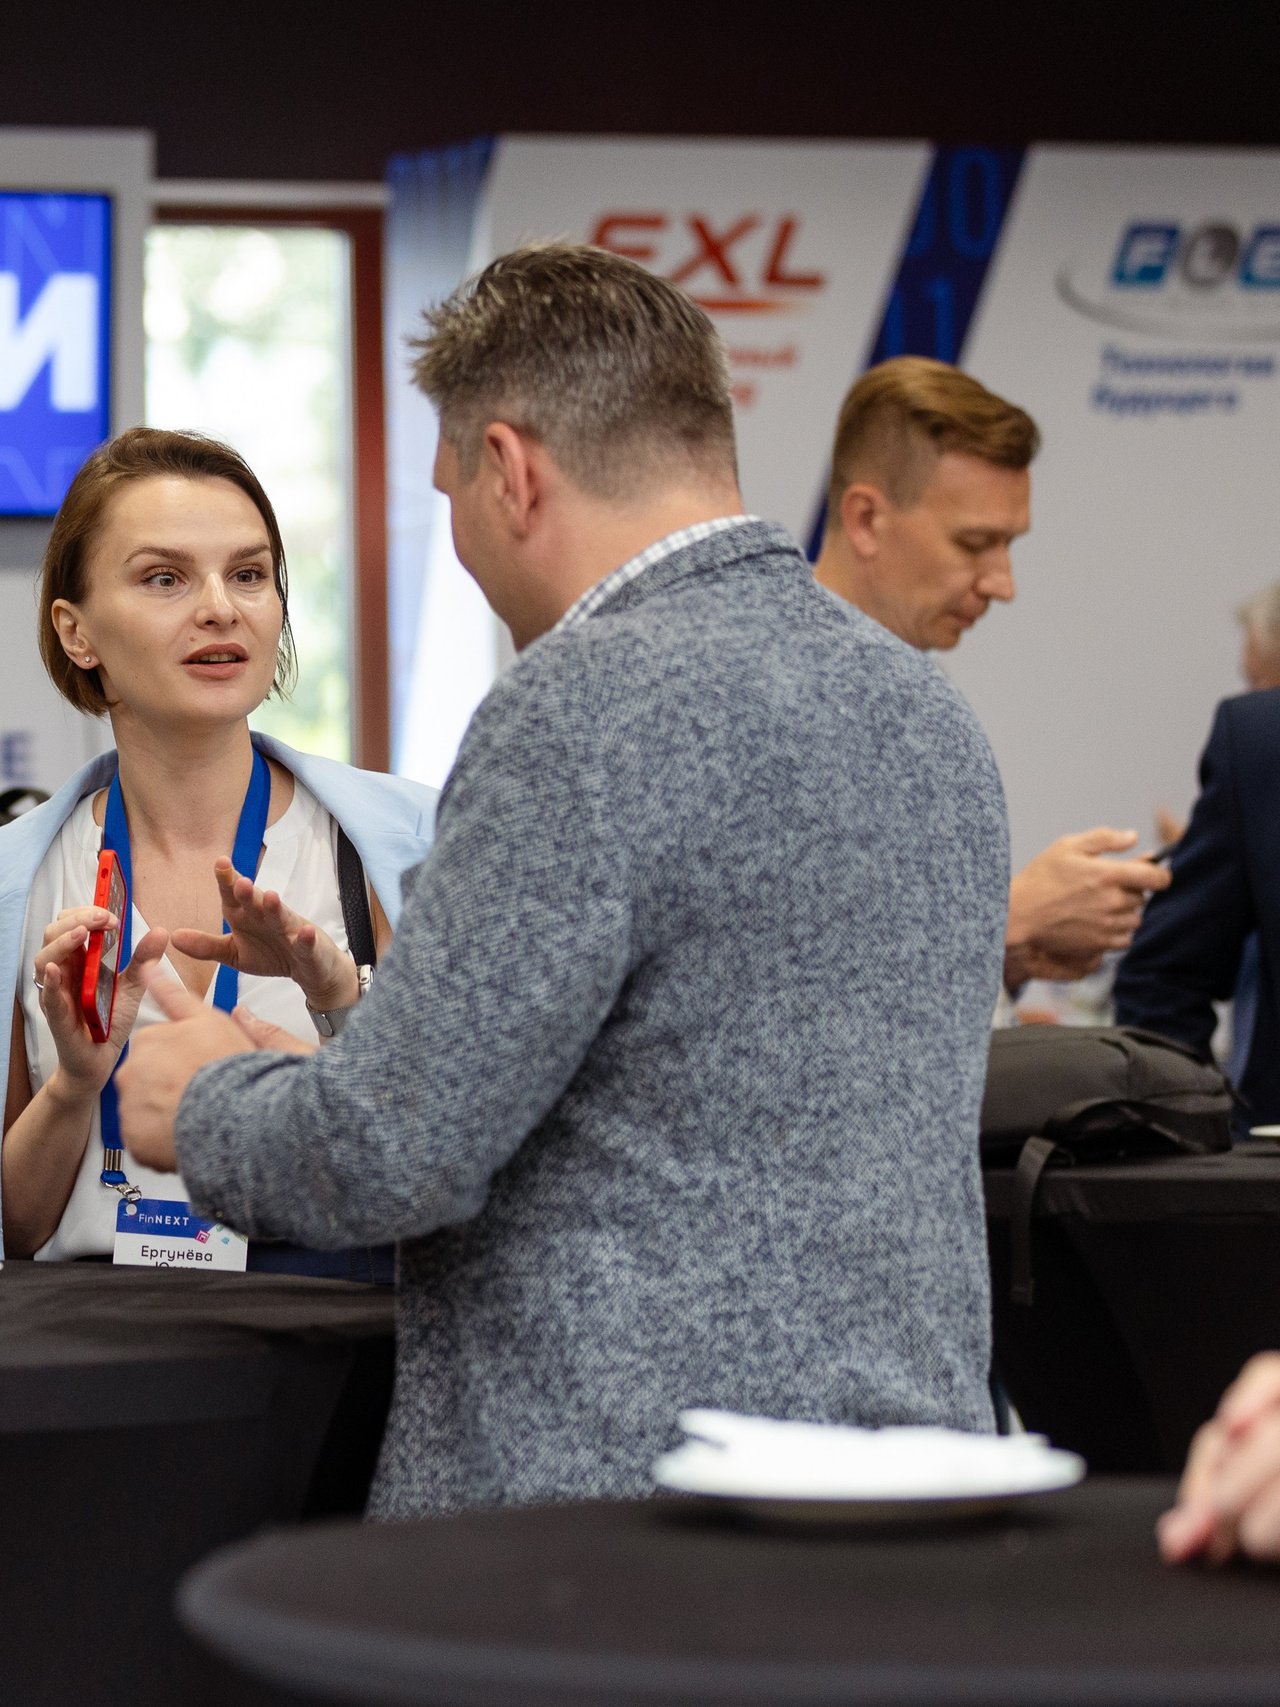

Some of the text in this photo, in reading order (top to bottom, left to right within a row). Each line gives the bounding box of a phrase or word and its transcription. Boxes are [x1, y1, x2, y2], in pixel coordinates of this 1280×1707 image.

[592, 211, 828, 292] EXL
[138, 1213, 190, 1227] FinNEXT
[140, 1245, 213, 1262] Ергунёва
